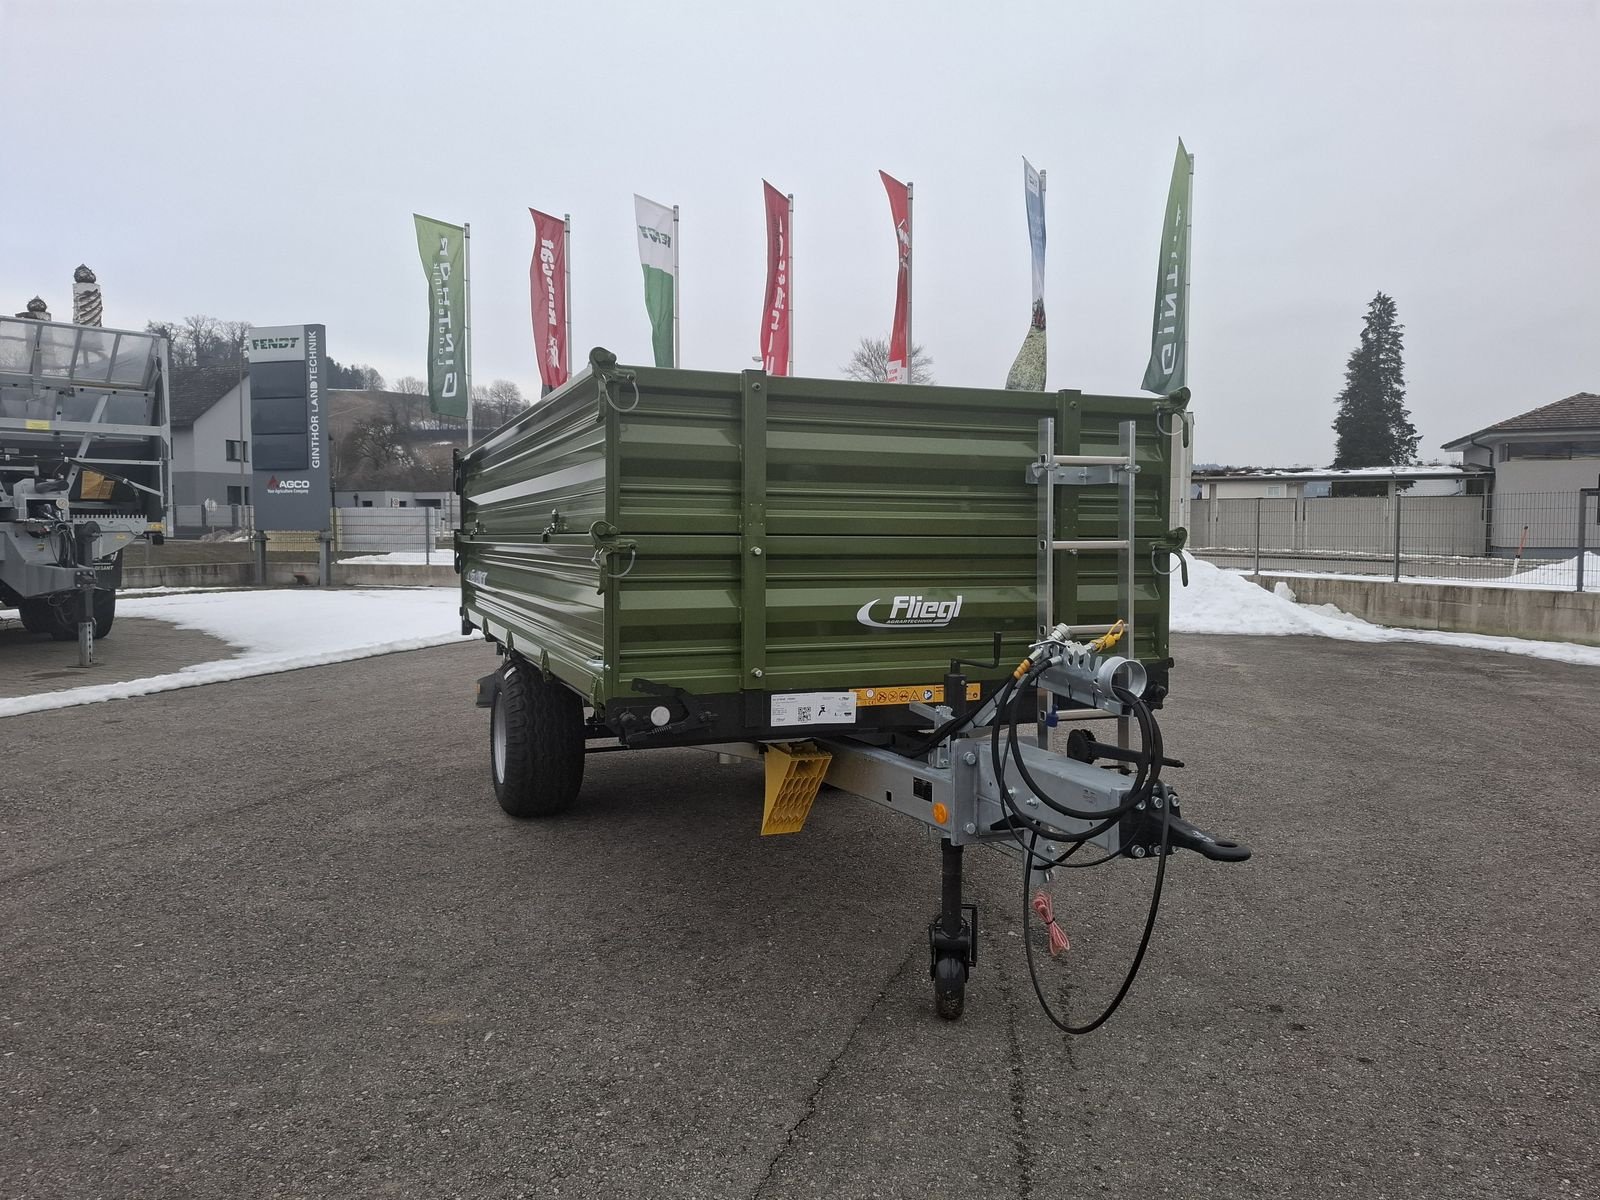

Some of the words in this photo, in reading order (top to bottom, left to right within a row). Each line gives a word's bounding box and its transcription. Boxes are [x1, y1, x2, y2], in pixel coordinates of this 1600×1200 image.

[252, 337, 299, 350] FENDT
[308, 331, 320, 413] LANDTECHNIK
[311, 415, 320, 469] GINTHÖR
[279, 480, 310, 489] AGCO
[889, 595, 963, 623] Fliegl
